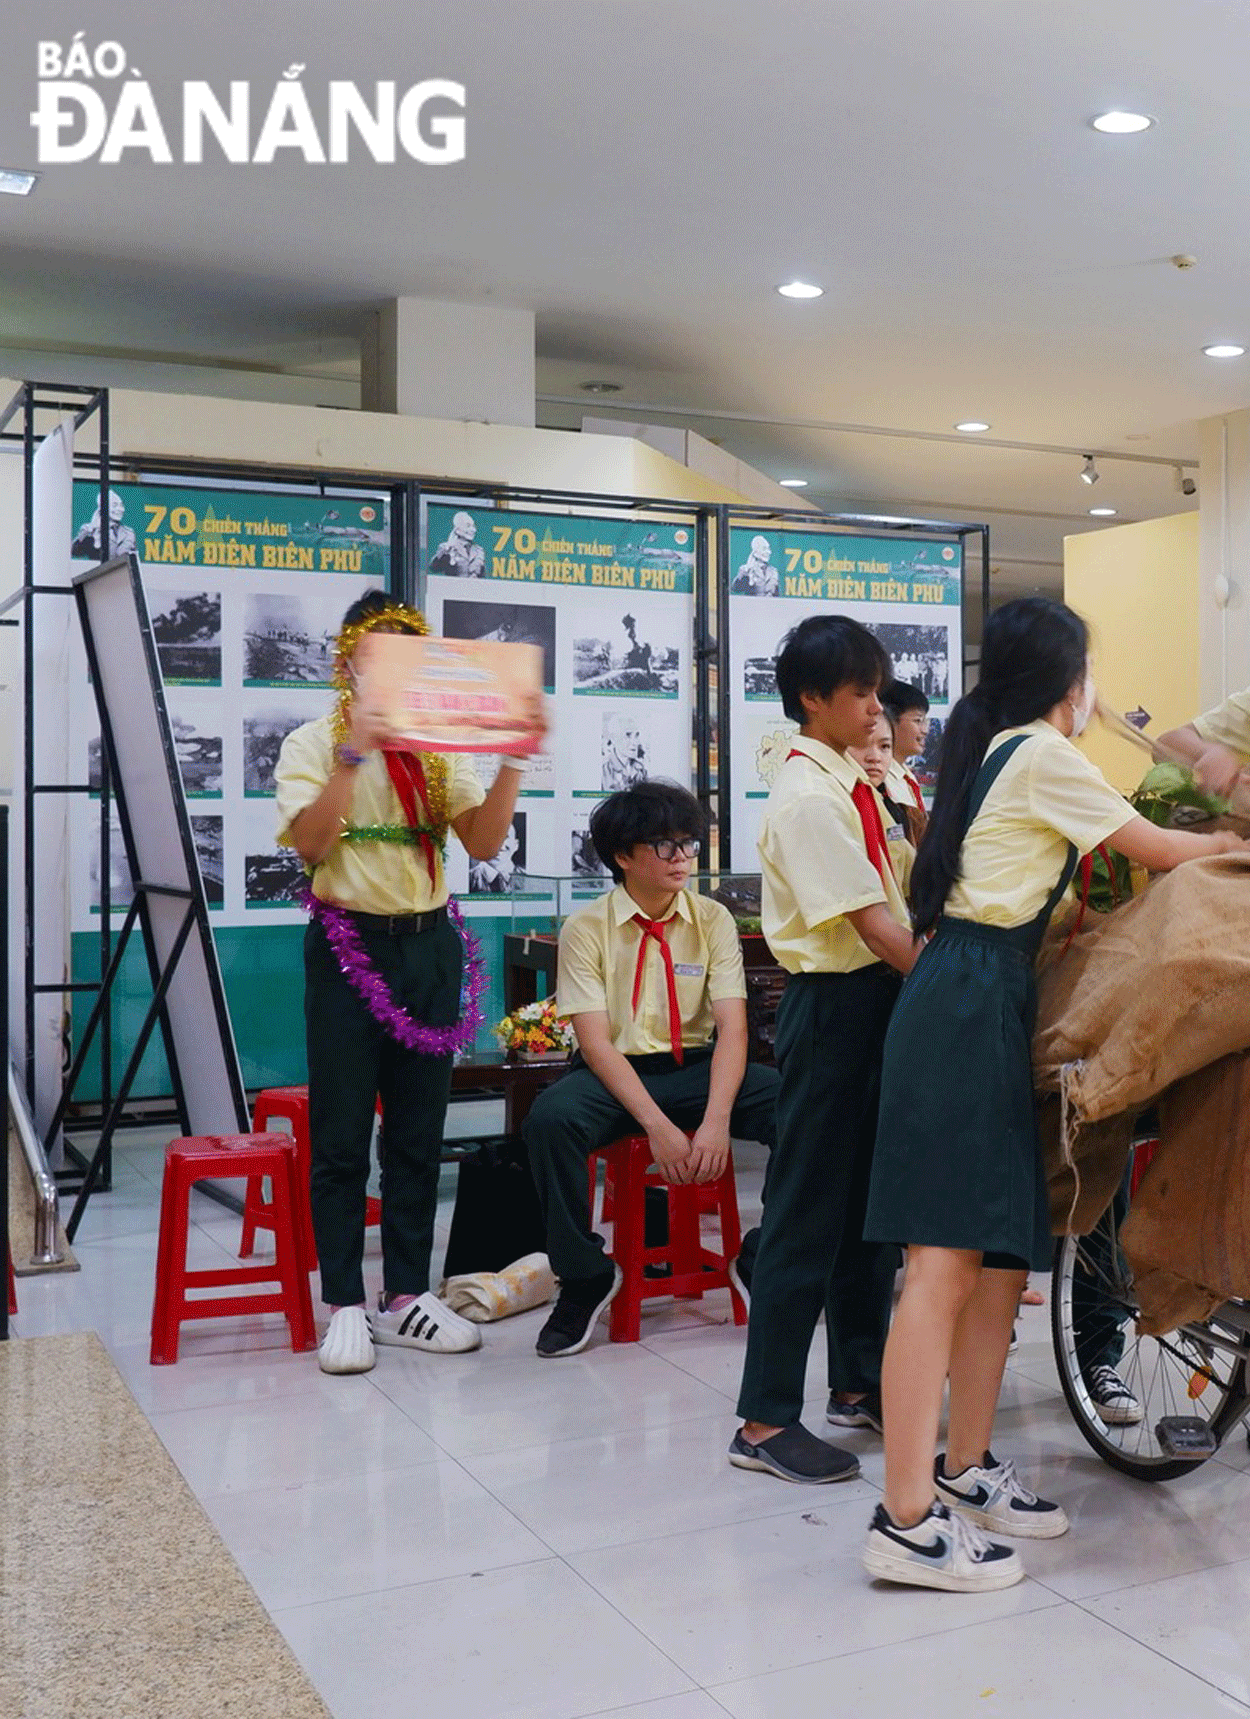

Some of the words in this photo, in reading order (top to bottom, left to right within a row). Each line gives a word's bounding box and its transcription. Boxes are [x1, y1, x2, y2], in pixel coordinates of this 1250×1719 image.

[144, 505, 197, 535] 70
[144, 535, 196, 564] NĂM
[262, 541, 314, 572] BIÊN
[492, 526, 536, 554] 70
[492, 554, 535, 580] NĂM
[591, 561, 635, 587] BIÊN
[784, 548, 822, 574] 70
[784, 573, 822, 597] NĂM
[870, 578, 908, 601] BIÊN
